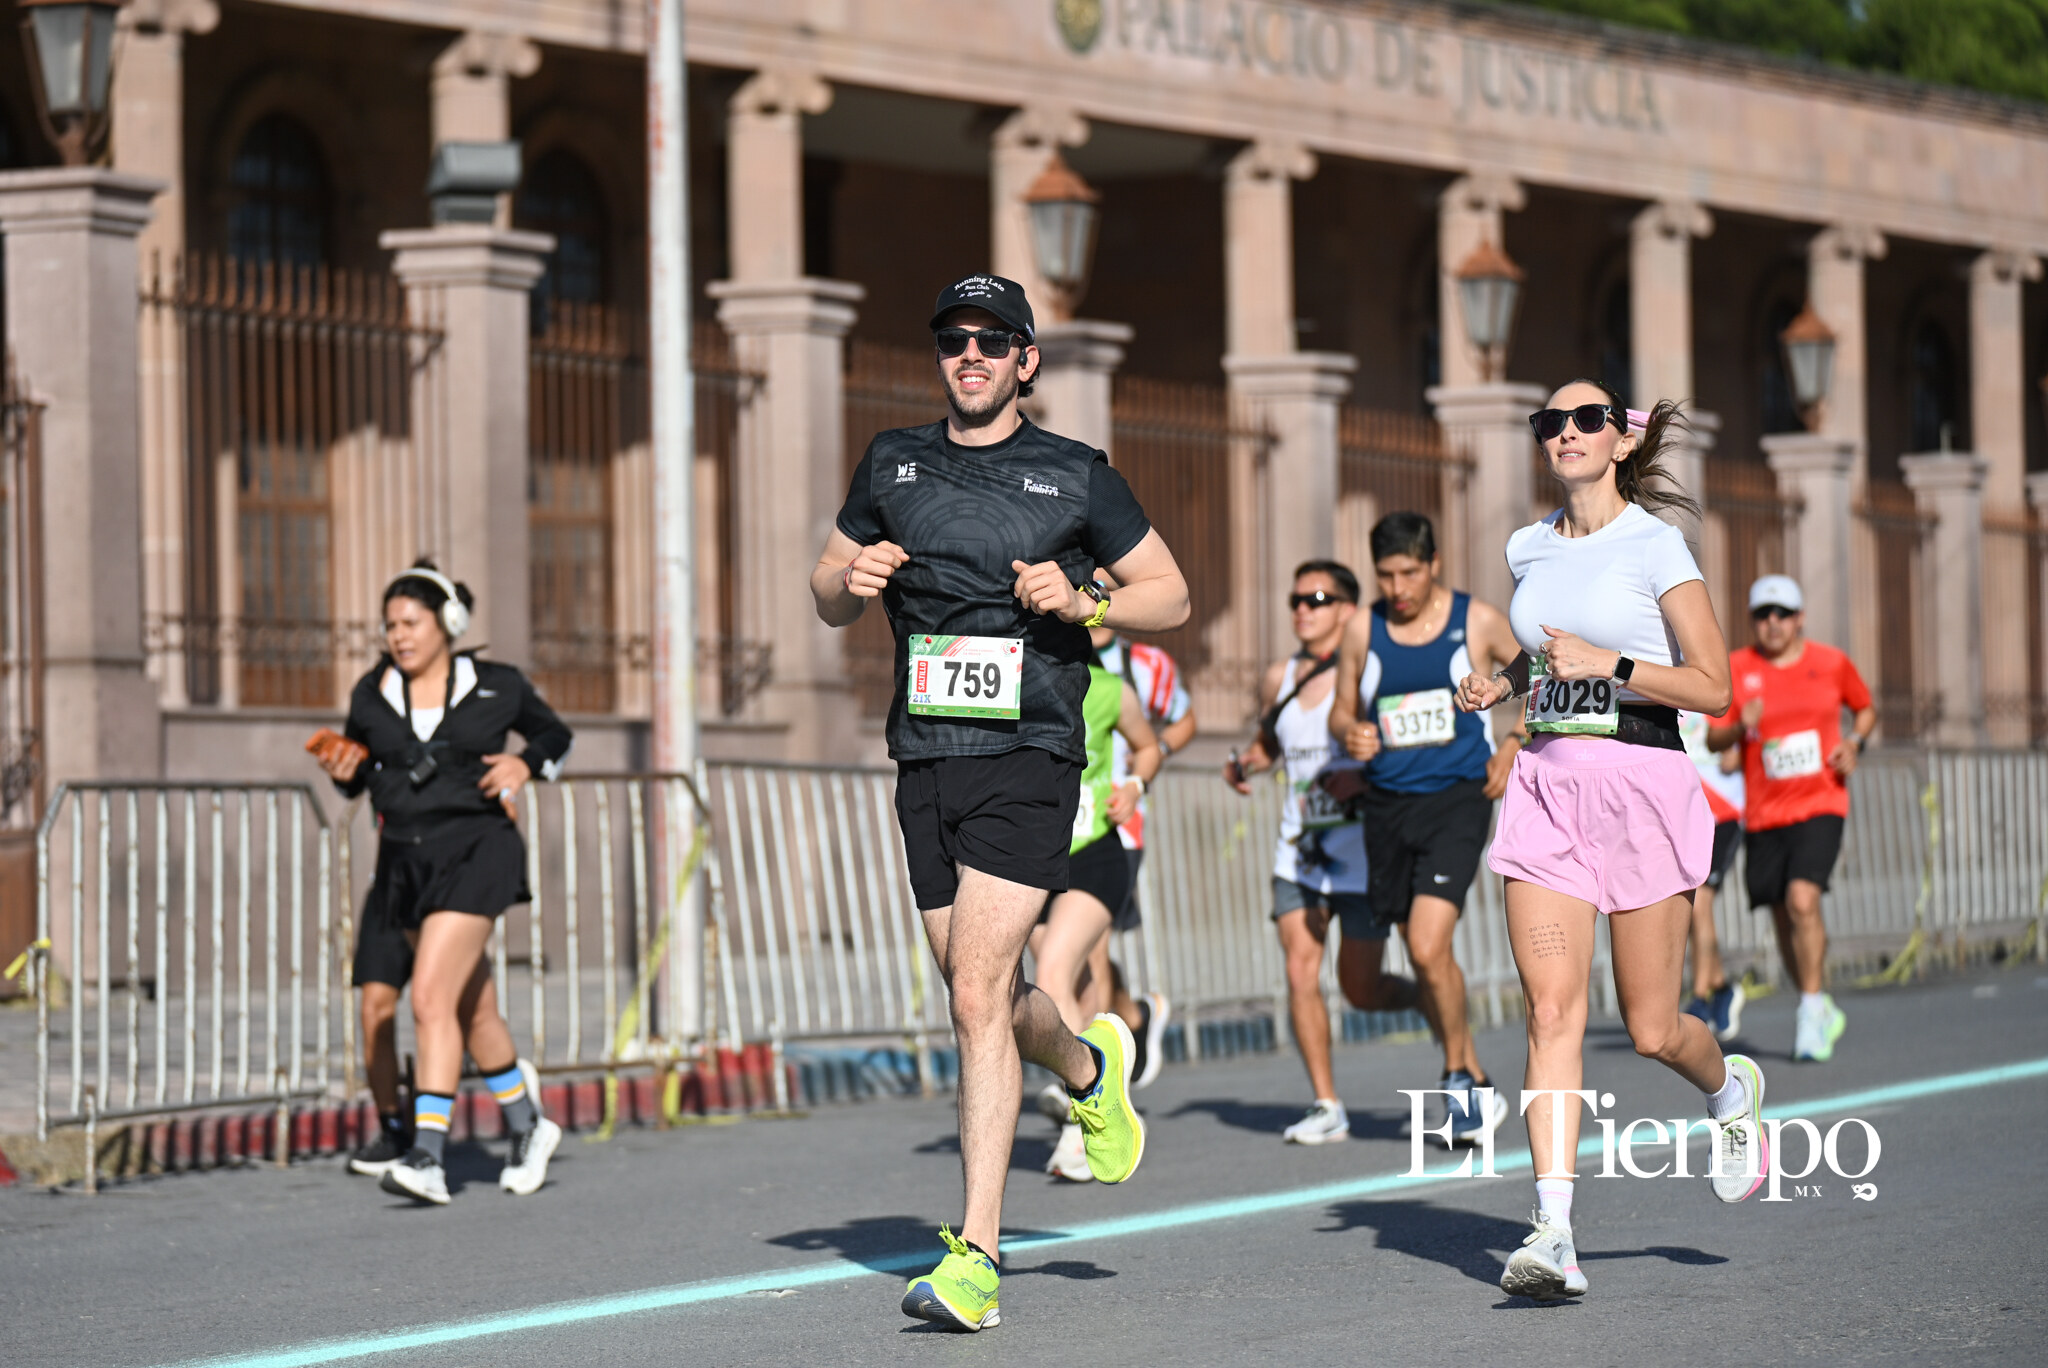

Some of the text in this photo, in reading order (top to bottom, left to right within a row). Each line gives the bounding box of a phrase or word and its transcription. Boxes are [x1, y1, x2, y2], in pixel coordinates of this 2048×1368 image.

[1116, 0, 1665, 132] PALACIO DE JUSTICIA
[917, 661, 927, 691] SALTILLO
[944, 661, 1001, 699] 759
[1540, 678, 1611, 715] 3029
[1394, 708, 1447, 737] 3375
